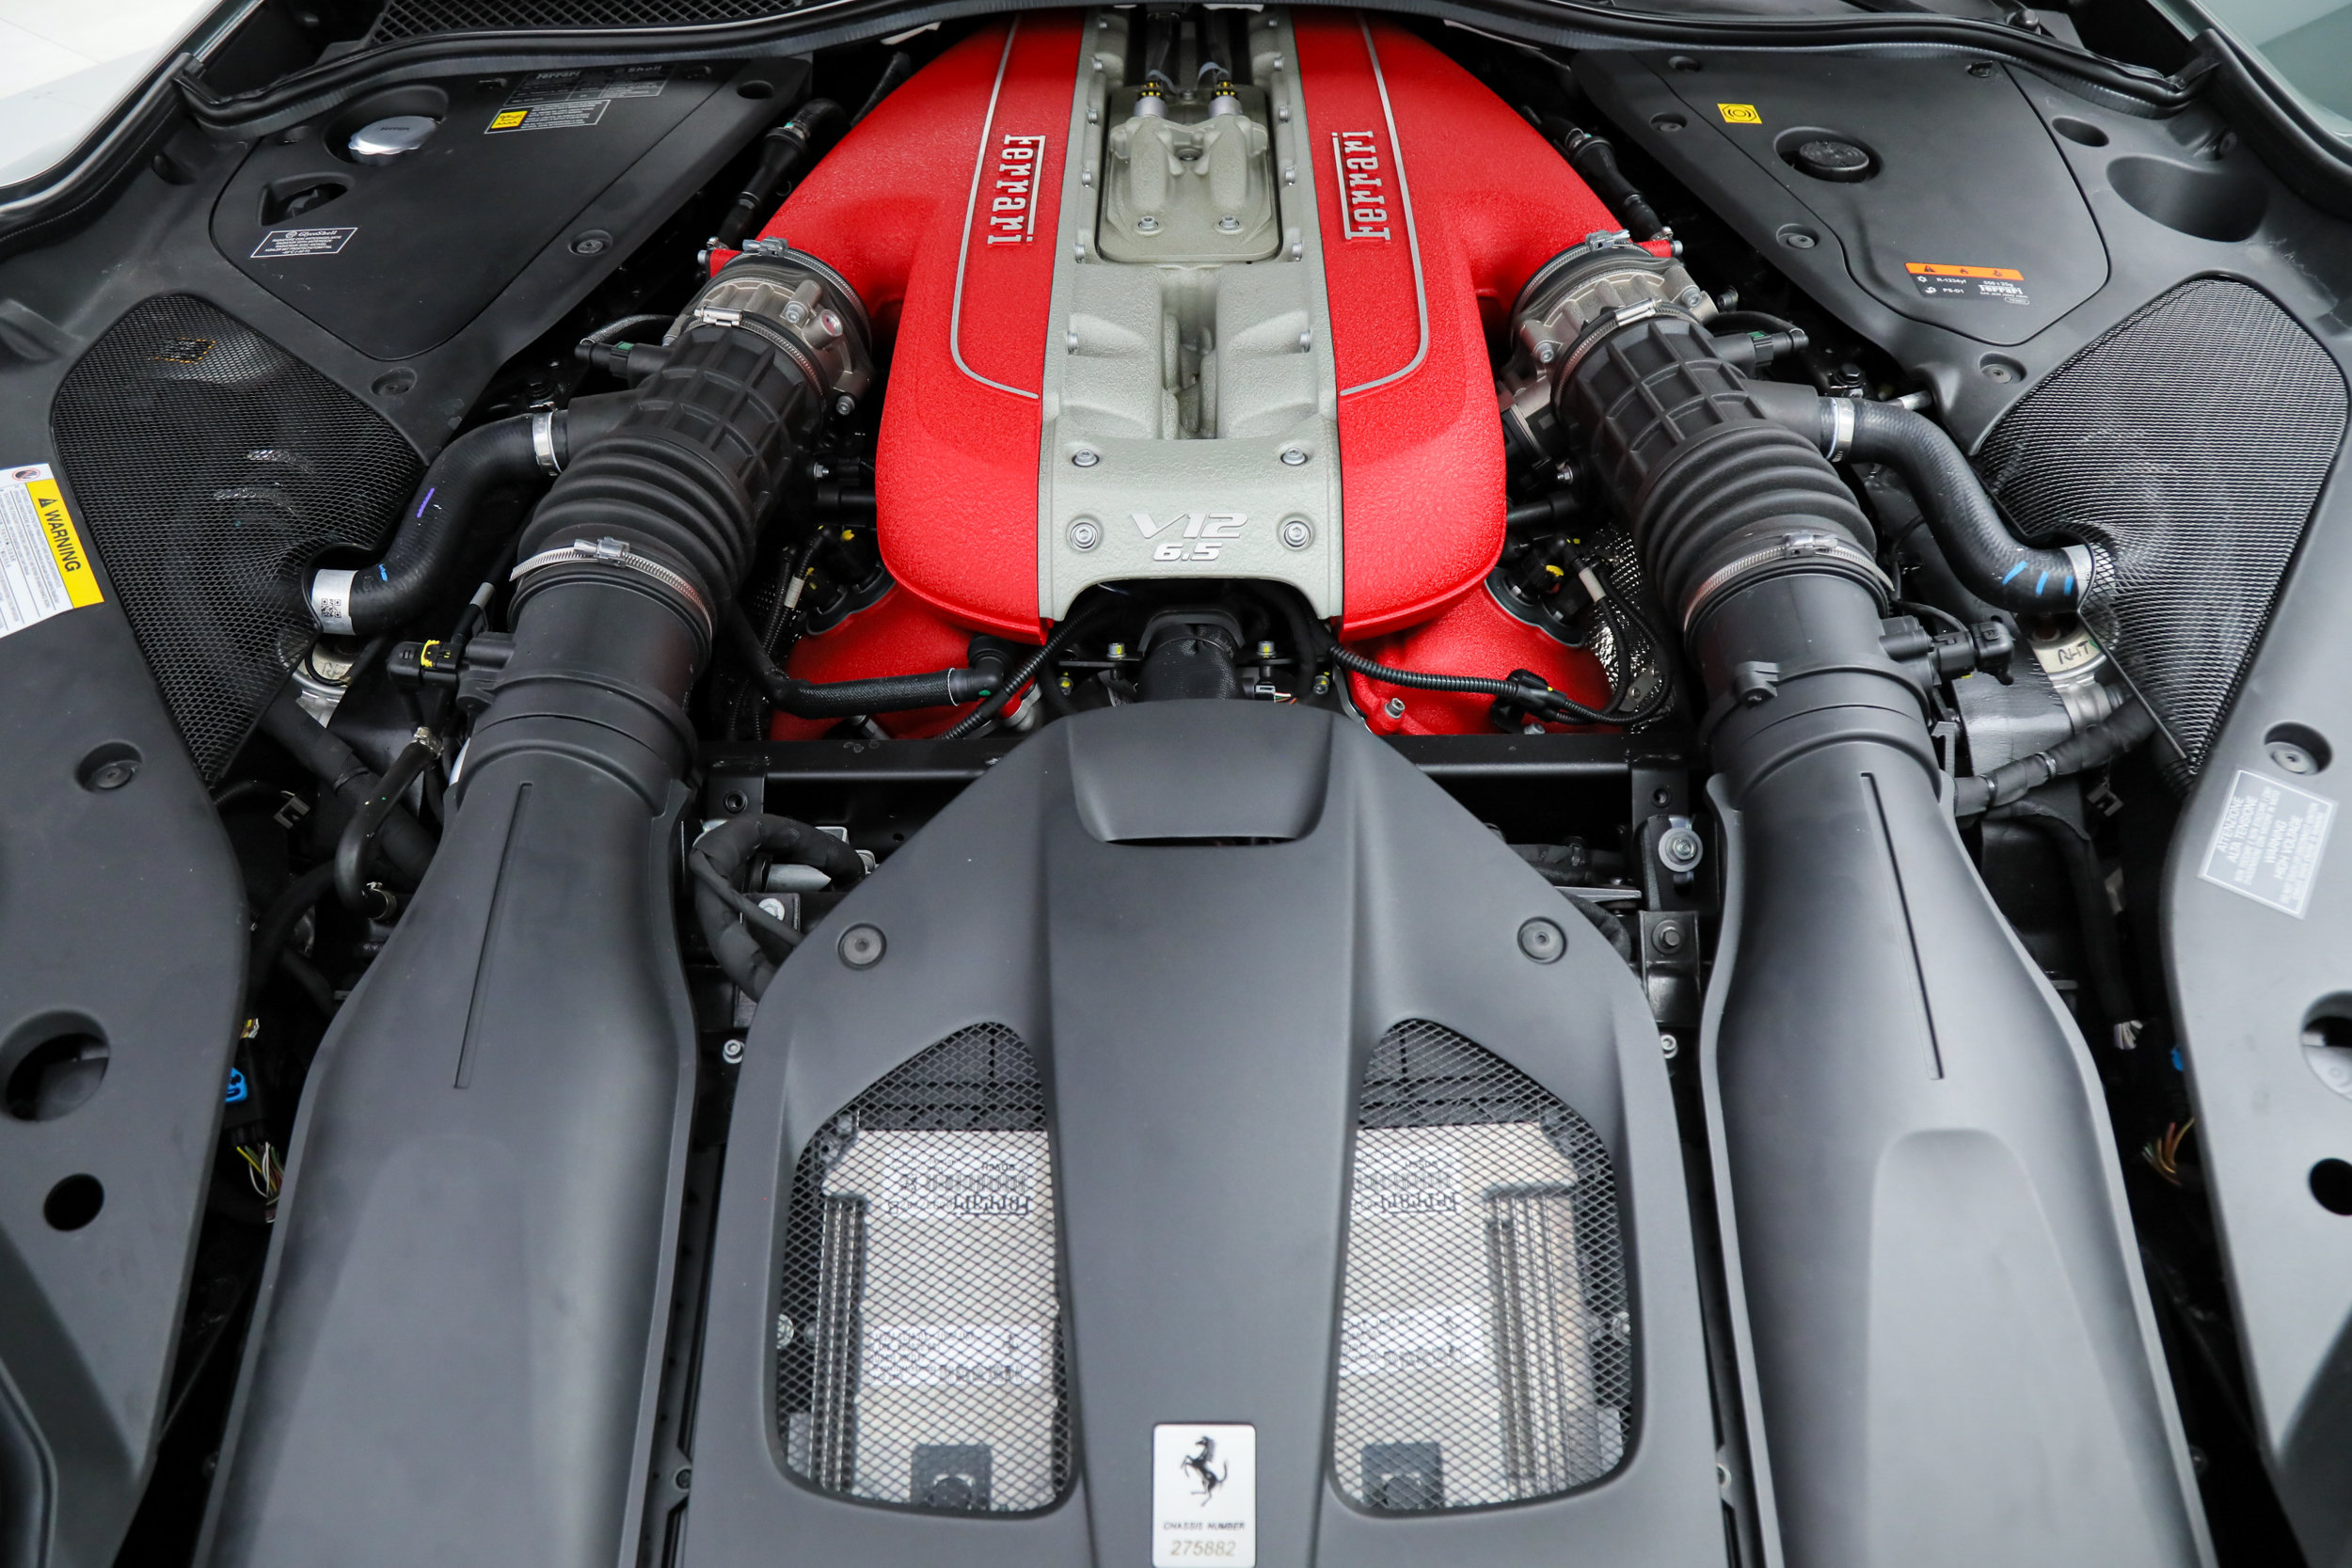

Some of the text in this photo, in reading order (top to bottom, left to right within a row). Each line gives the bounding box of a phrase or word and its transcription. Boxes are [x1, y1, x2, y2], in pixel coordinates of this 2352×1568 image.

[987, 135, 1046, 245] Ferrari
[1331, 131, 1391, 240] Ferrari
[1978, 284, 2023, 294] Ferrari
[44, 509, 82, 573] WARNING
[1130, 512, 1249, 539] V12
[1153, 542, 1223, 562] 6.5
[2216, 795, 2245, 853] ATTENZIONE
[2227, 795, 2258, 863] ALTA TENSIONE
[2265, 819, 2288, 863] WARNING
[1163, 1521, 1246, 1531] CHASSIS NUMBER
[1170, 1540, 1236, 1557] 275882
